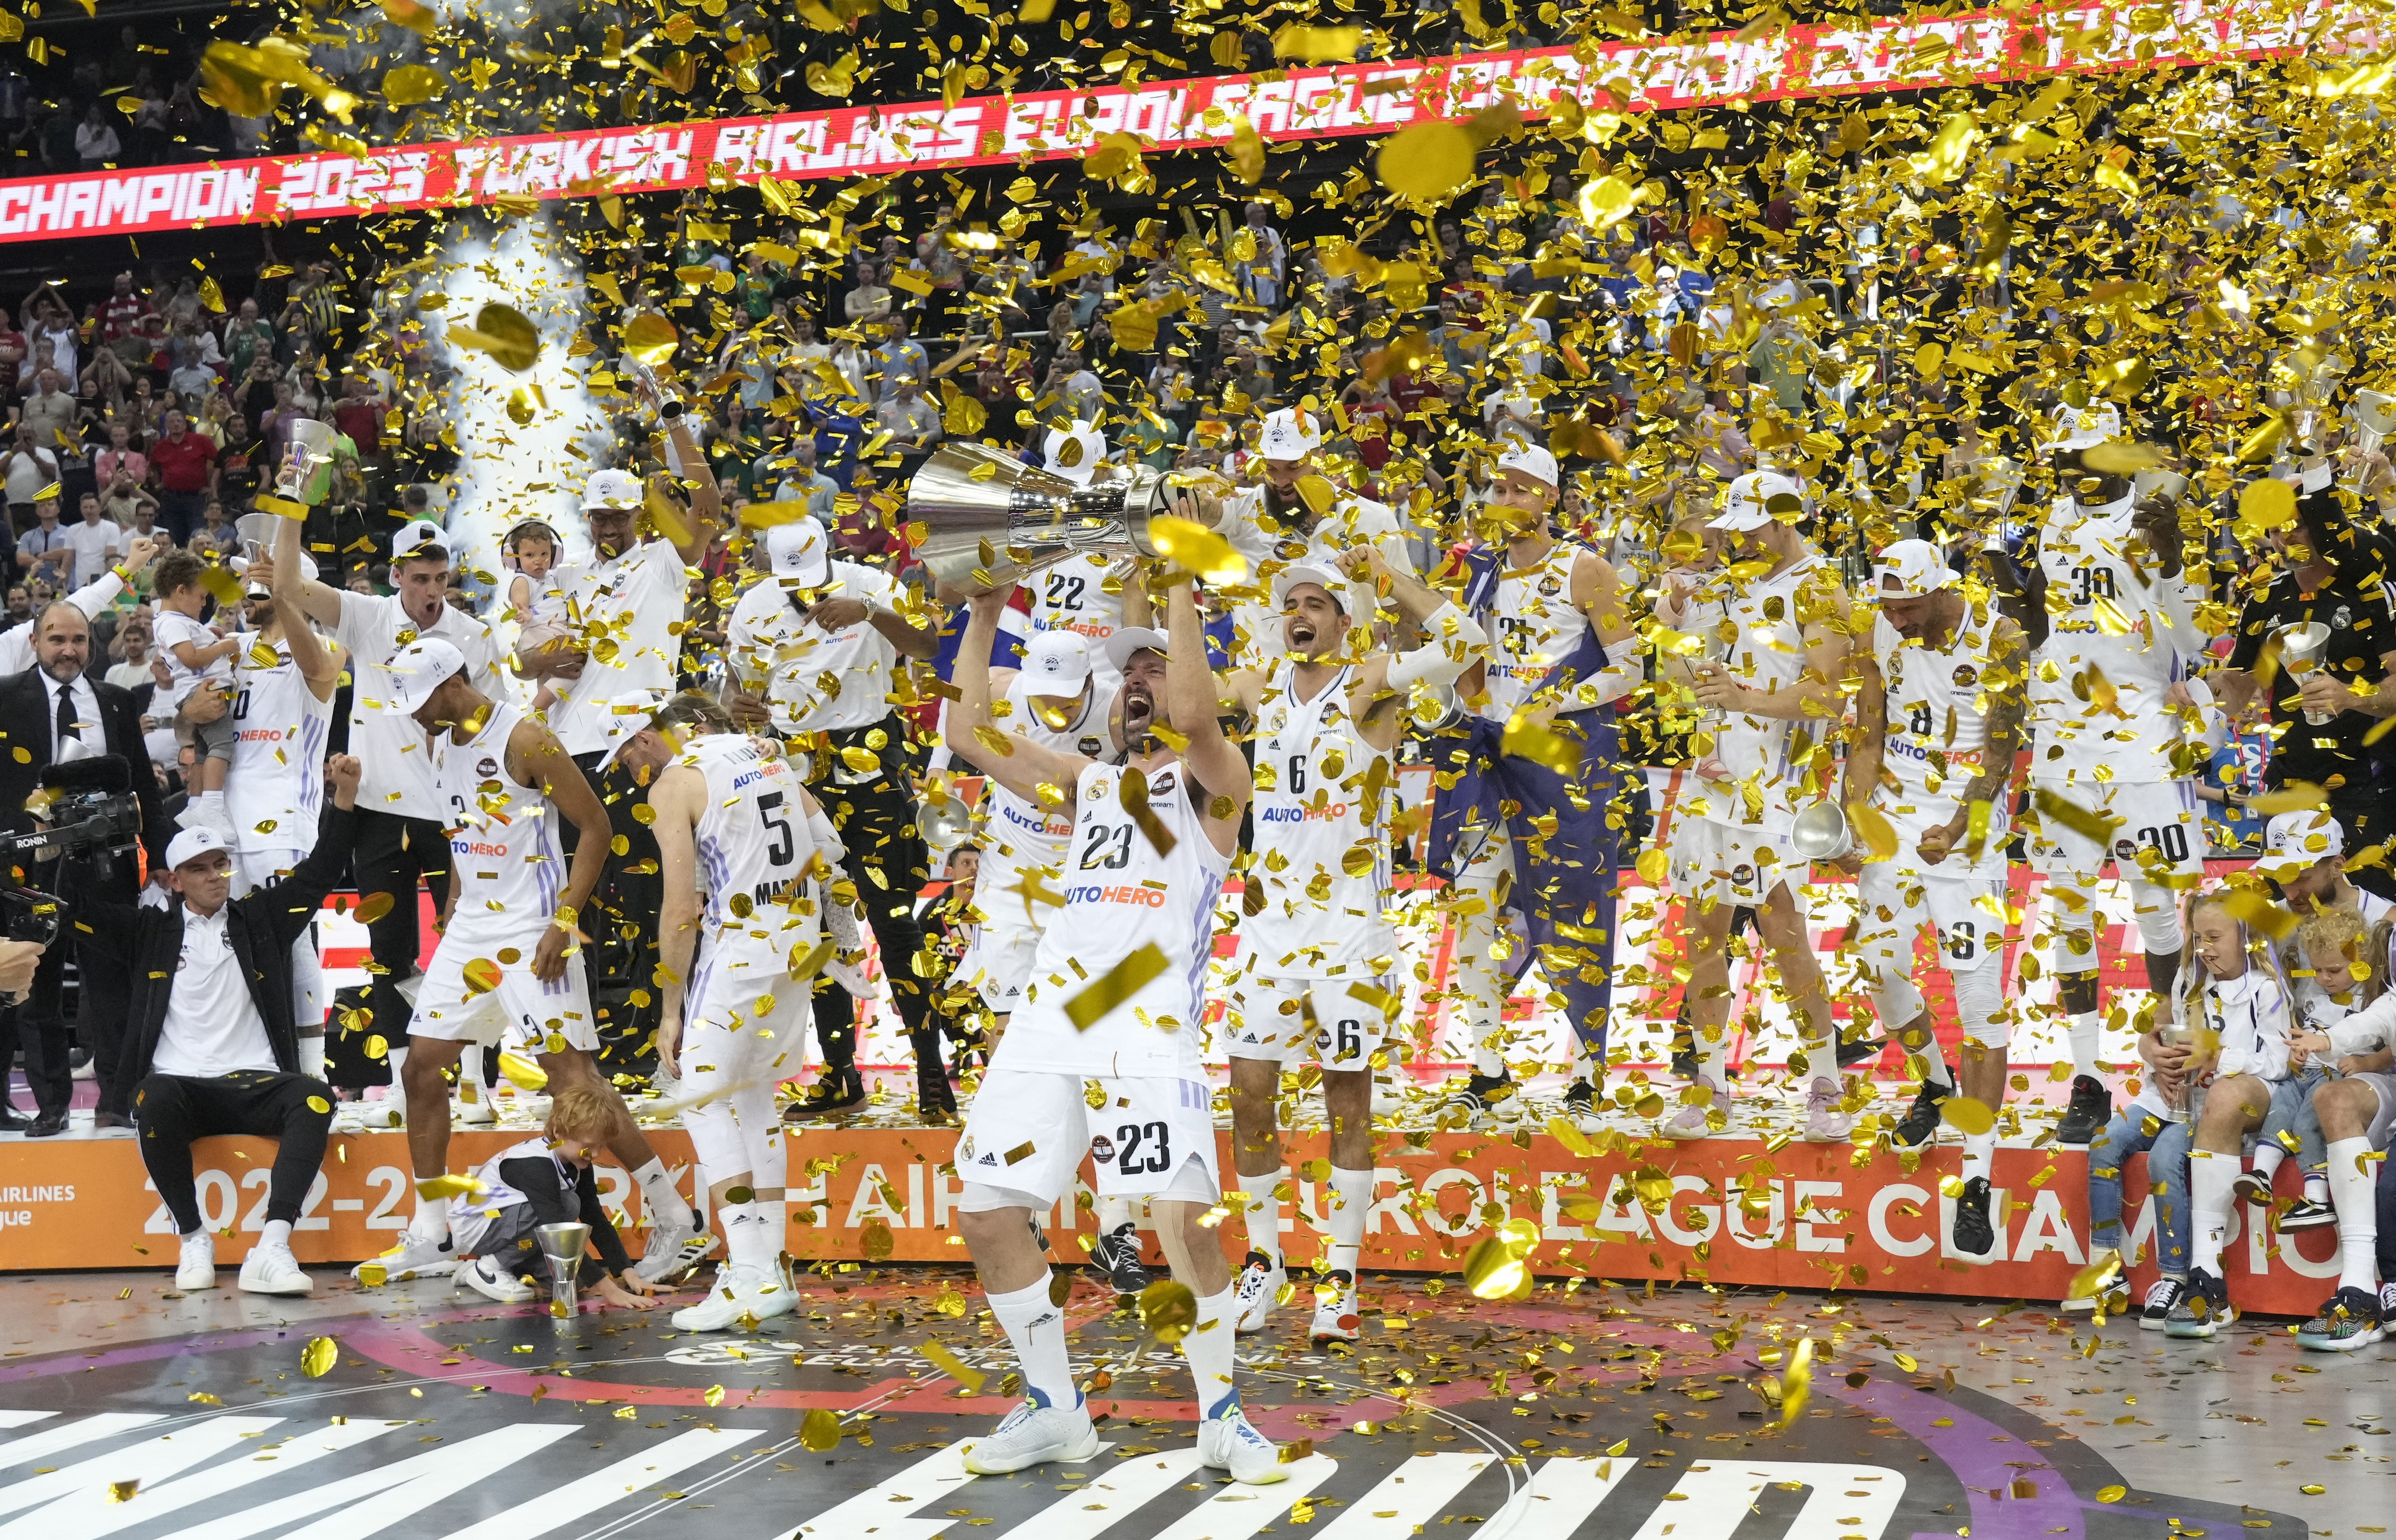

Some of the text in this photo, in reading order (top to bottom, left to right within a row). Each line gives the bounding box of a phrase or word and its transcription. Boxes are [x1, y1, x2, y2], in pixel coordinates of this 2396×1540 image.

[0, 165, 259, 234] CHAMPION
[281, 152, 429, 211] 2023
[455, 129, 694, 195] TURKISH
[712, 107, 982, 173] AIRLINES
[1046, 574, 1086, 611] 22
[2071, 567, 2115, 605] 30
[826, 634, 858, 644] AUTOHERO
[1911, 706, 1932, 736] 8
[1890, 736, 1983, 765] AUTOERO
[734, 764, 786, 790] AUTOHERO
[1289, 755, 1306, 794] 6
[451, 795, 470, 829] 3
[757, 791, 794, 866] 5
[1003, 805, 1073, 836] AUTOHE
[16, 835, 48, 849] RONIN
[452, 840, 507, 857] TOHERO
[1079, 824, 1133, 871] 23
[2137, 824, 2189, 862] 30
[1065, 885, 1165, 908] UTOHERO
[1951, 922, 1975, 960] 8
[1338, 1020, 1360, 1059] 6
[1117, 1121, 1170, 1175] 23
